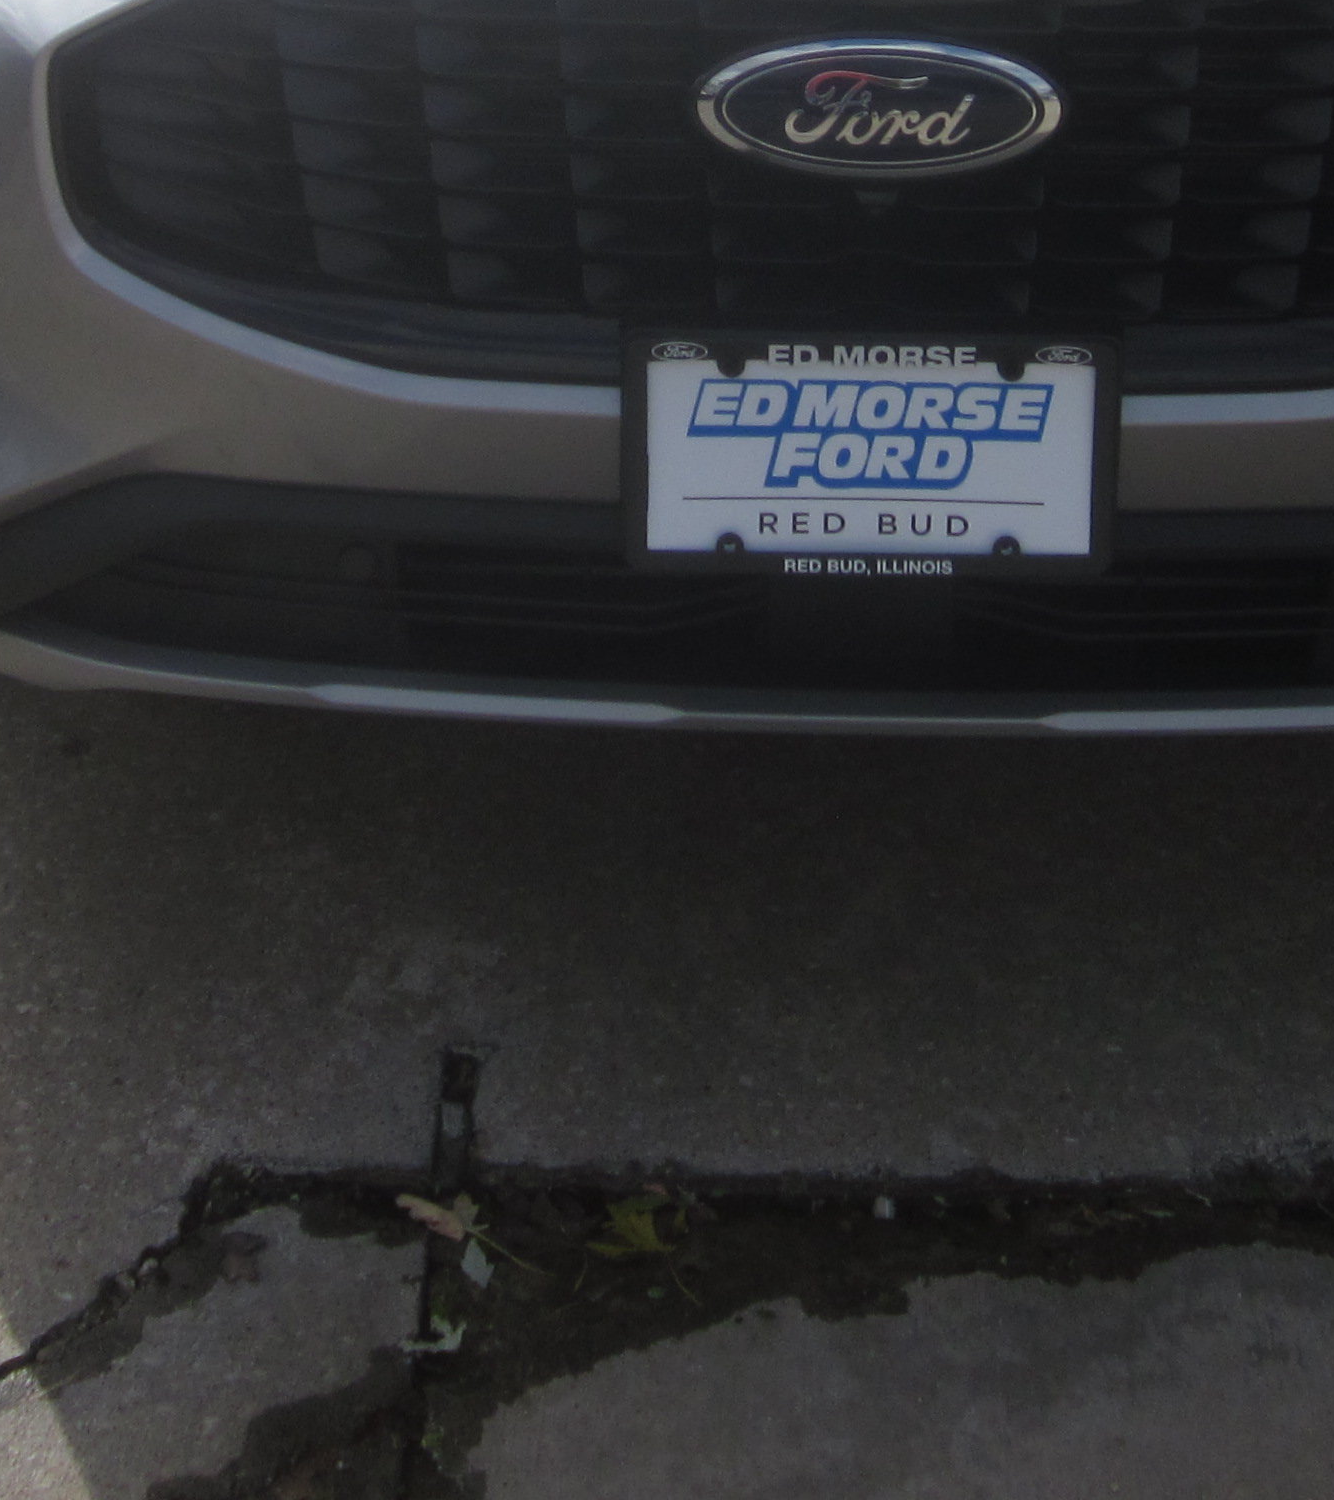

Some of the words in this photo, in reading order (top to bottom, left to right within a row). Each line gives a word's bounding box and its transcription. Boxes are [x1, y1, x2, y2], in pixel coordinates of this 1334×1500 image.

[785, 70, 975, 146] Ford
[767, 344, 820, 366] ED
[832, 344, 977, 368] MORSE
[689, 380, 793, 432] ED
[791, 381, 1052, 436] MORSE
[767, 433, 971, 486] FORD
[758, 512, 846, 535] RED
[878, 513, 969, 537] BUD
[783, 558, 822, 573] RED
[827, 558, 872, 576] BUD,
[877, 559, 954, 575] ILLINOIS
